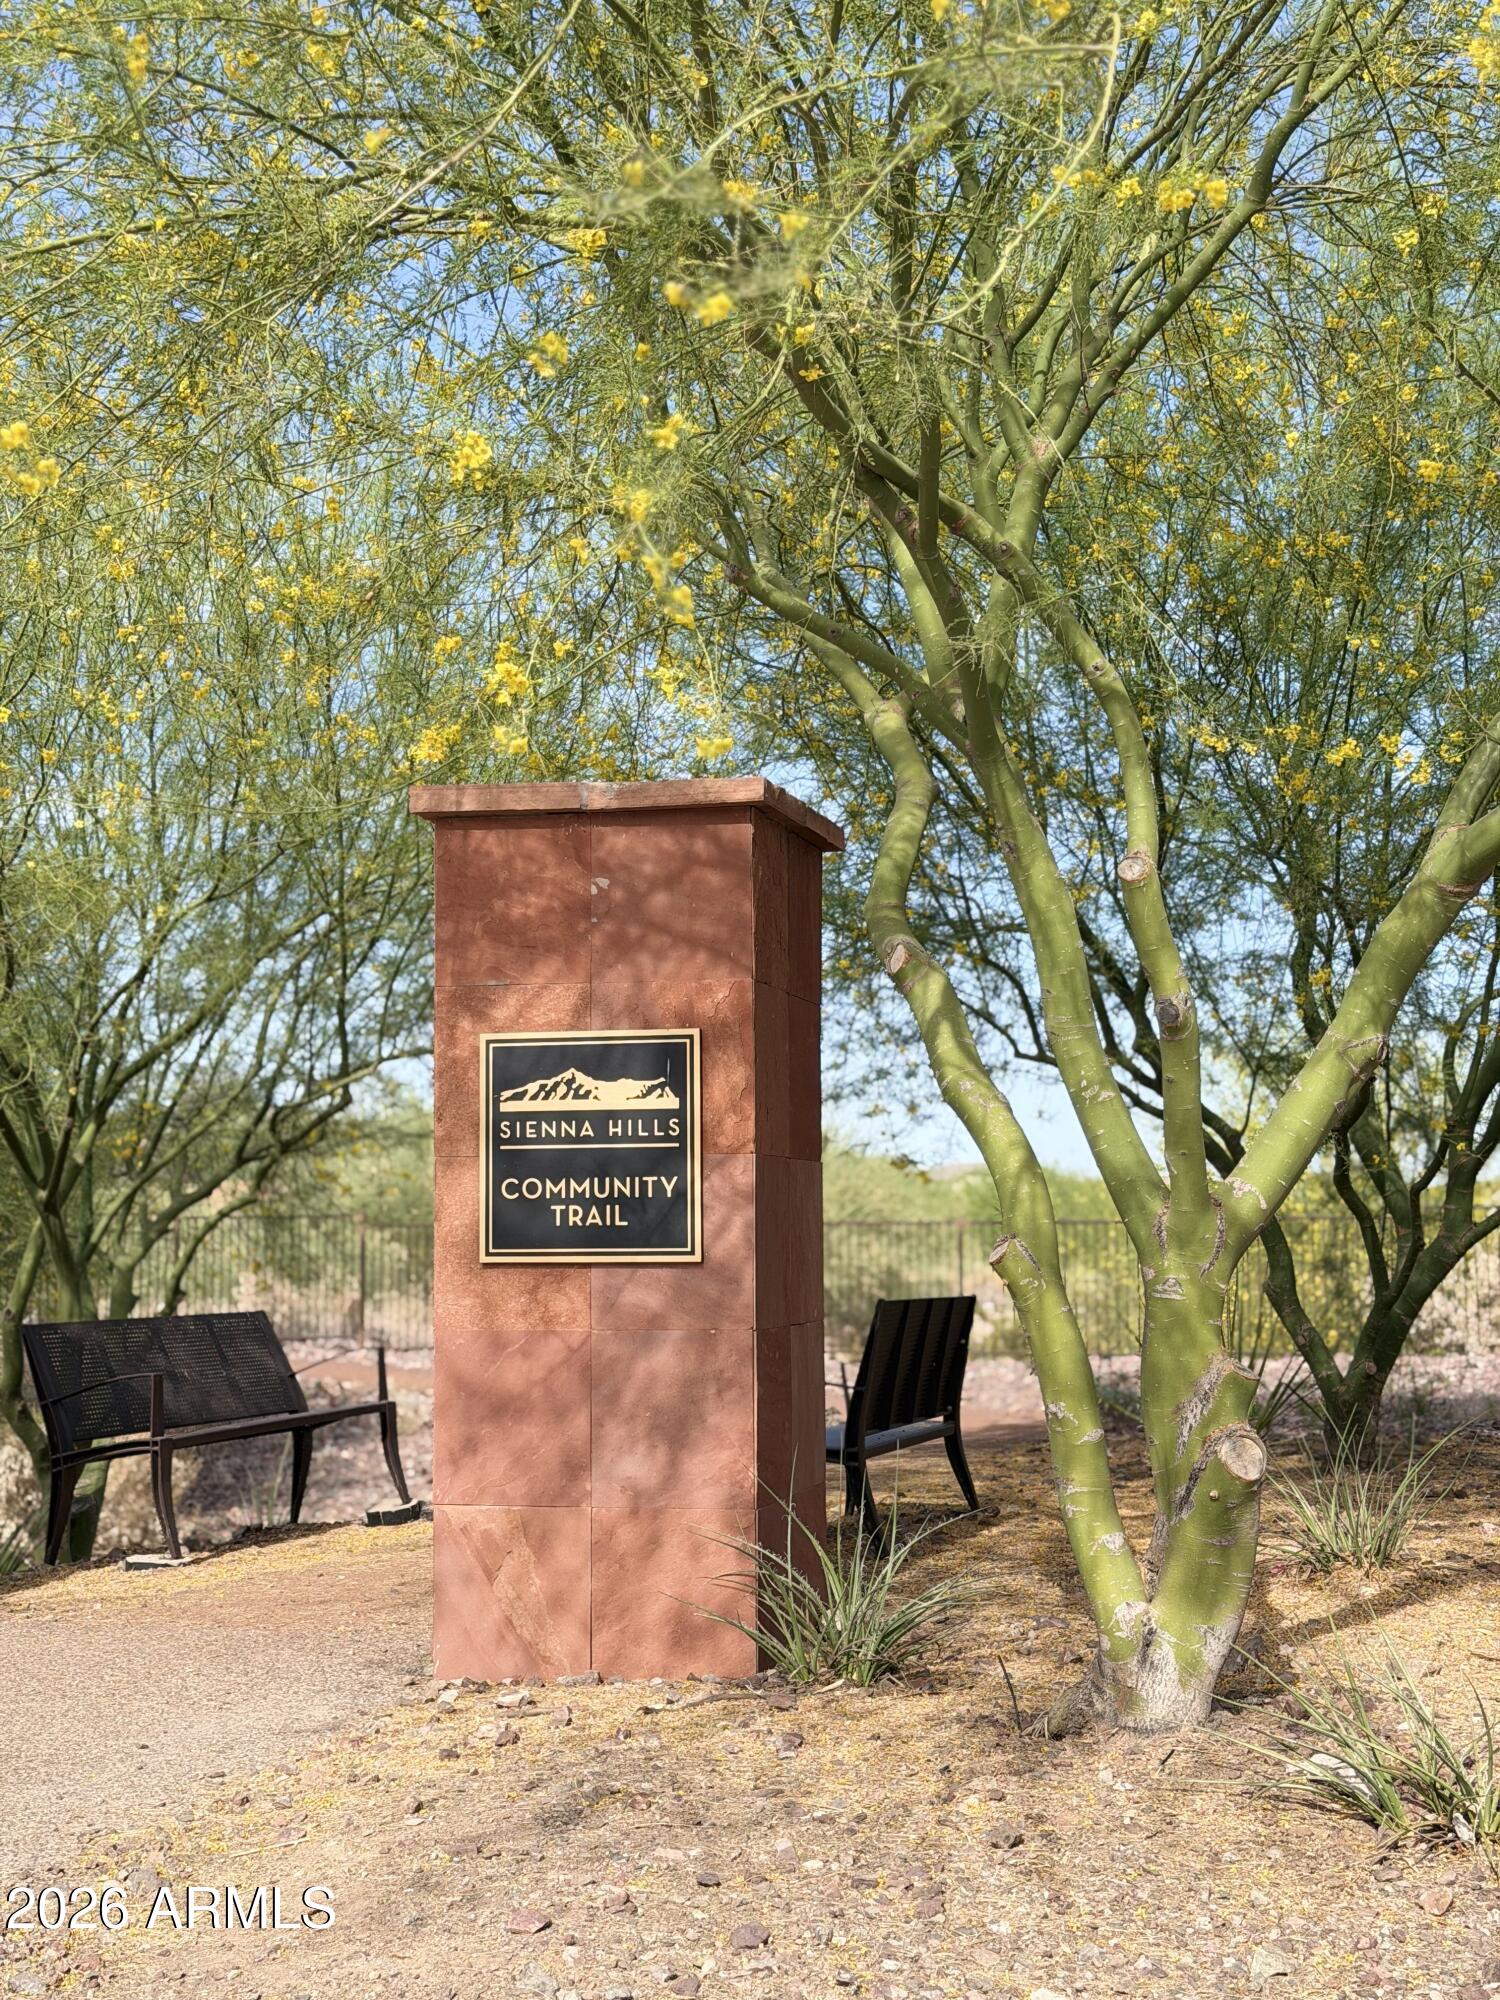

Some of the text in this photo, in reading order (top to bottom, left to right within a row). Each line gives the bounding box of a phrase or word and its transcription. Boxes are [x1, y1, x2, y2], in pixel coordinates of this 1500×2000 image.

[499, 1118, 680, 1139] SIENNA HILLS
[501, 1176, 678, 1199] COMMUNITY
[550, 1204, 628, 1227] TRAIL
